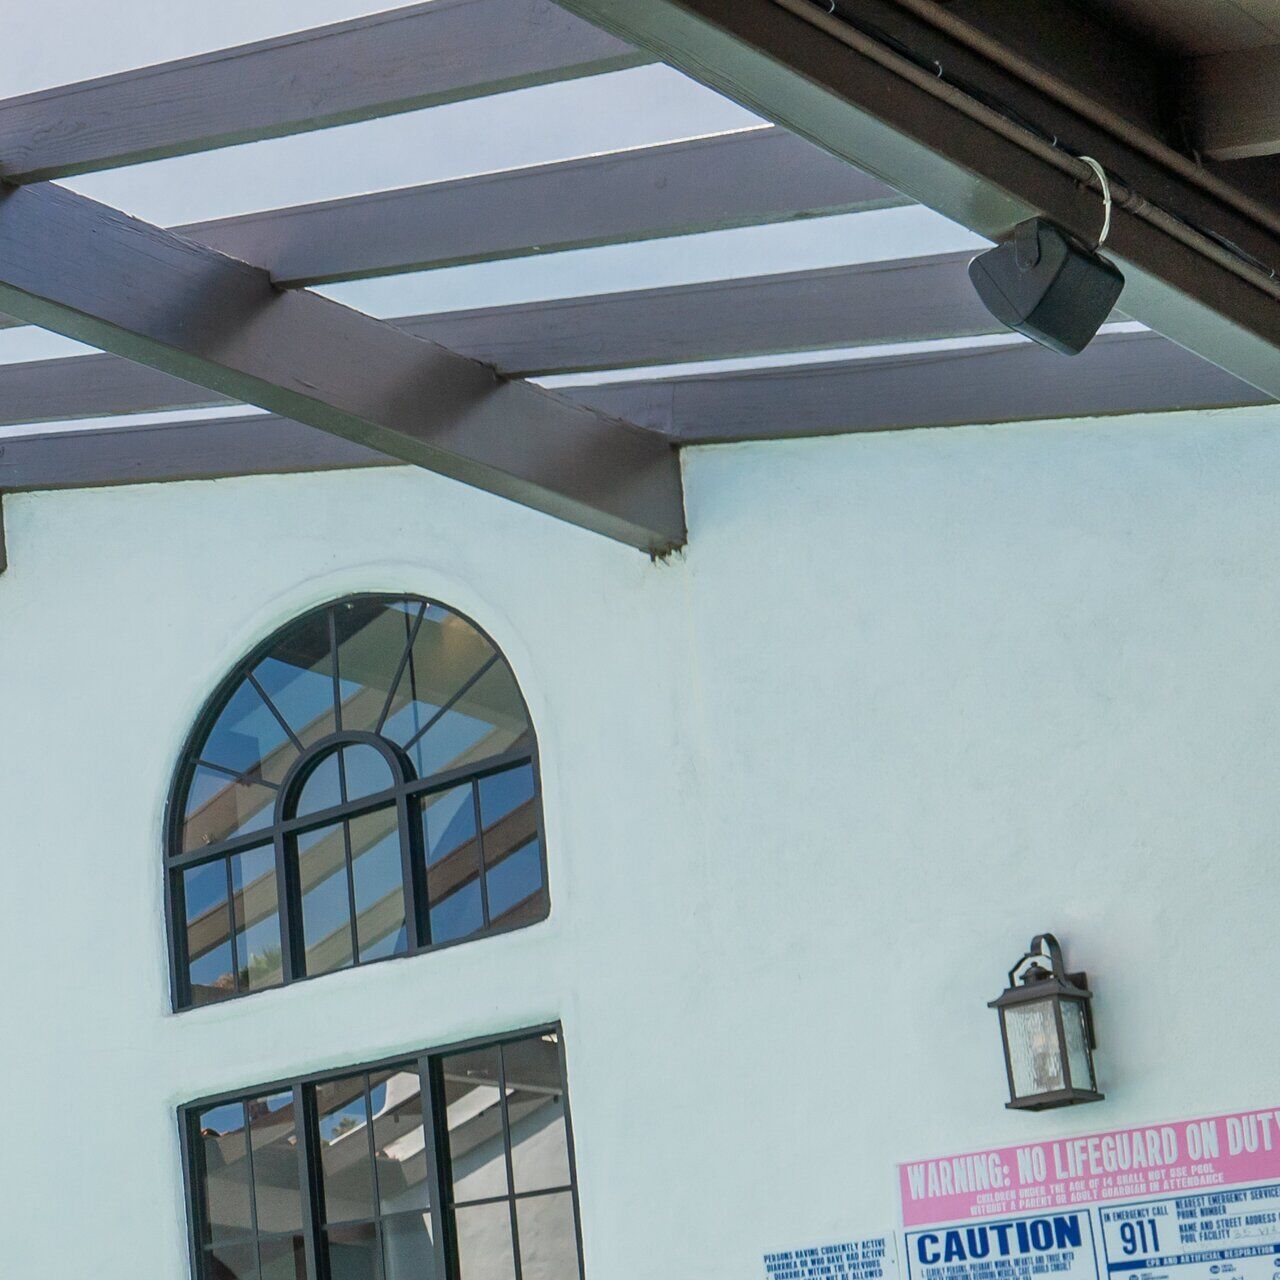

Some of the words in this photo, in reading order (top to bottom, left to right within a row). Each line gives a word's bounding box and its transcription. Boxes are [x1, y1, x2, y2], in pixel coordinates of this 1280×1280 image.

[907, 1152, 1011, 1200] WARNING:
[1016, 1145, 1046, 1185] NO
[1054, 1126, 1179, 1179] LIFEGUARD
[1186, 1120, 1219, 1160] ON
[1175, 1197, 1204, 1209] NEAREST
[1207, 1191, 1247, 1205] EMERGENCY
[1103, 1212, 1110, 1222] IN
[1112, 1207, 1149, 1221] EMERGENCY
[1151, 1205, 1168, 1216] CALL
[1176, 1208, 1196, 1219] PHONE
[1199, 1205, 1227, 1217] NUMBER
[1177, 1222, 1196, 1233] NAME
[1200, 1220, 1213, 1231] AND
[1216, 1217, 1241, 1229] STREET
[1245, 1212, 1277, 1226] ADDRESS
[917, 1215, 1082, 1265] CAUTION
[1120, 1219, 1160, 1255] 911
[1179, 1233, 1195, 1244] POOL
[1199, 1229, 1230, 1242] FACILITY
[1145, 1258, 1160, 1267] CPR
[1162, 1256, 1177, 1266] AND
[1180, 1251, 1220, 1264] ARTIFICIAL
[1224, 1245, 1275, 1259] RESPIRATION
